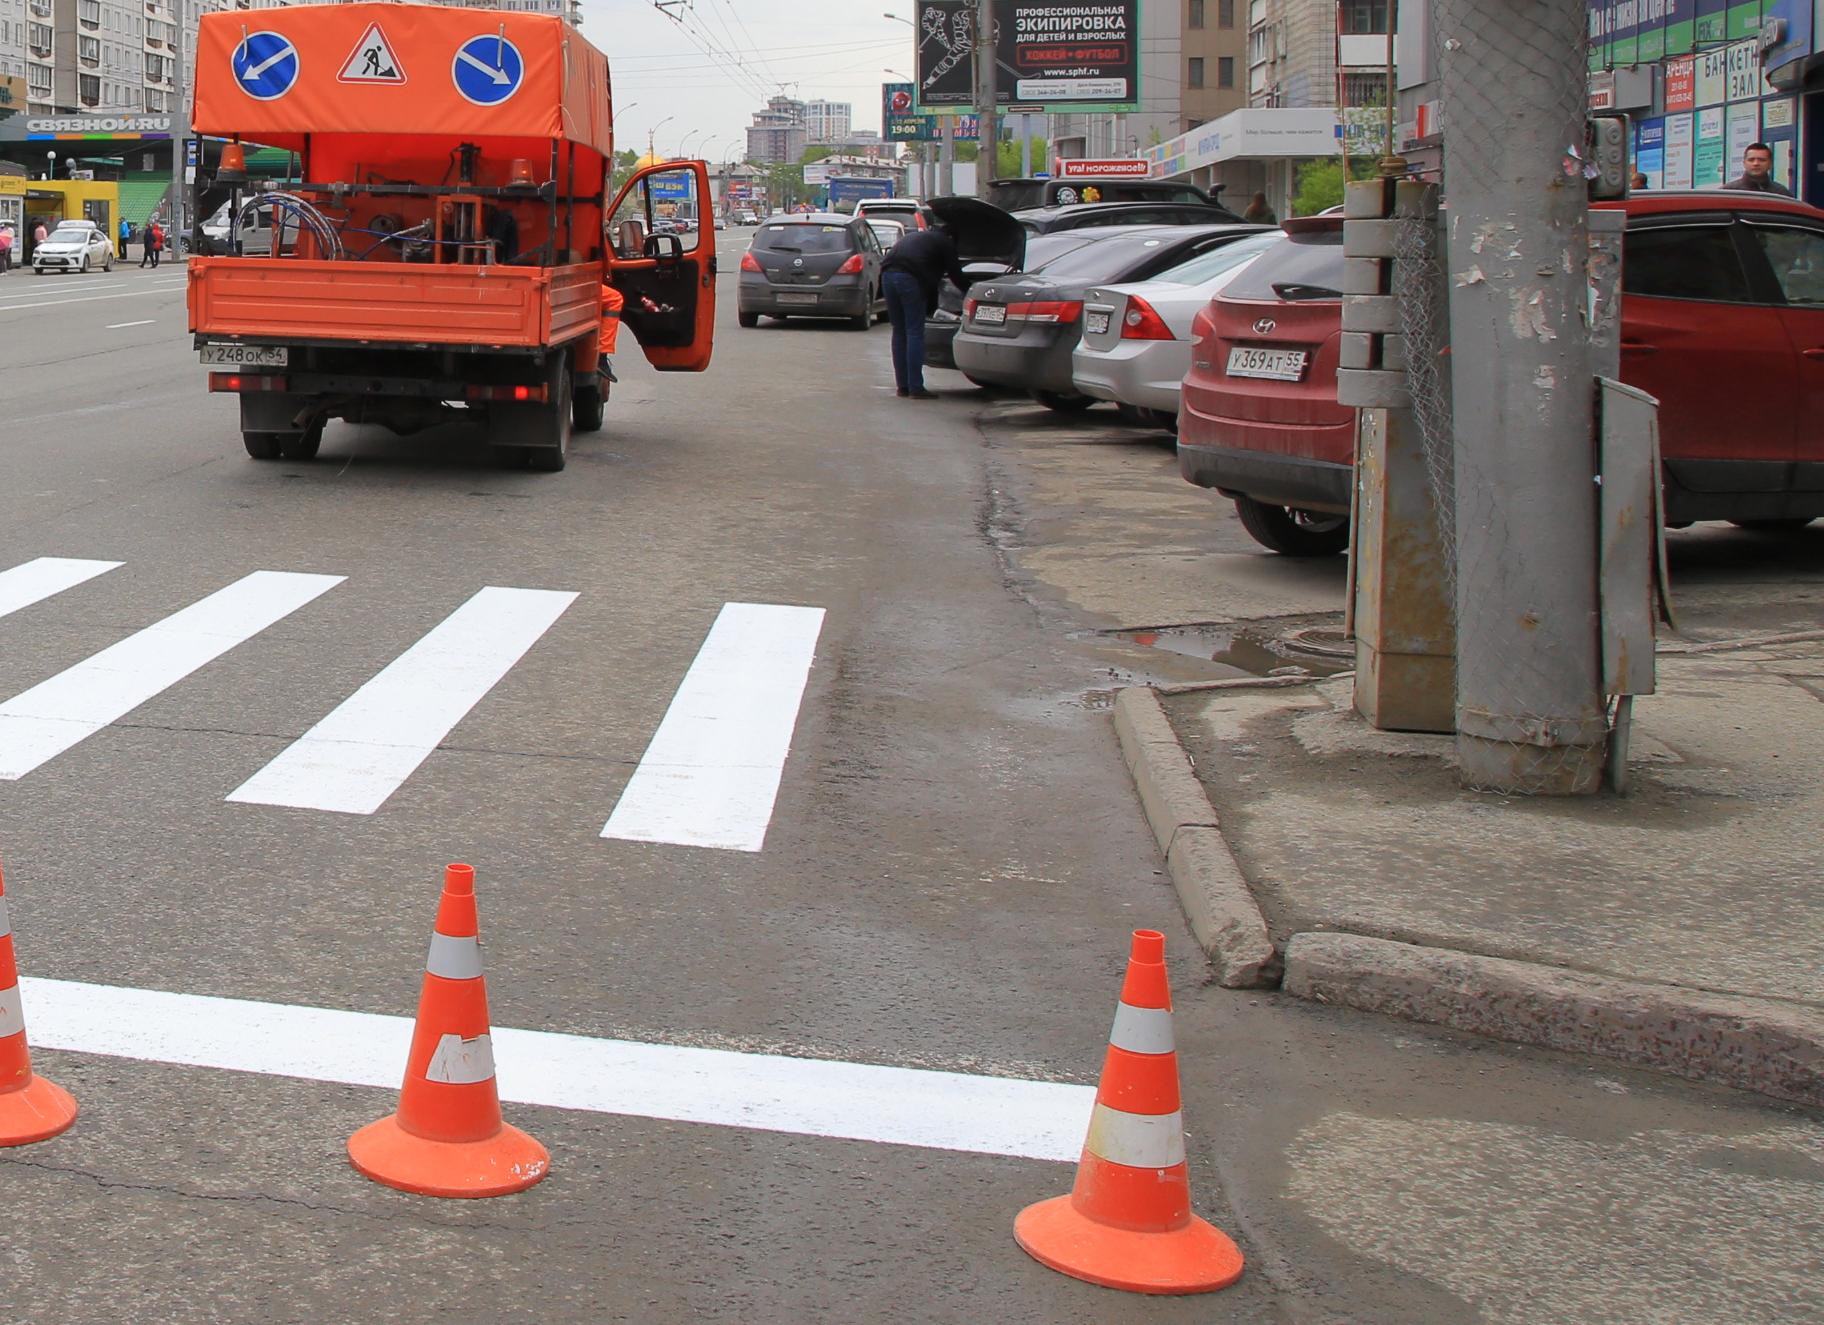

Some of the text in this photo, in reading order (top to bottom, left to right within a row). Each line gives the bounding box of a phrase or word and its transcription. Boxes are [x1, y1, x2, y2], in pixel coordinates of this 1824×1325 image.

[1016, 6, 1125, 17] ПРОФЕССИОНАЛЬНАЯ
[1016, 16, 1126, 31] ЭКИПИРОВКА
[1016, 31, 1126, 42] ДЛЯ ДЕТЕЙ И ВЗРОСЛЫХ
[1026, 48, 1120, 60] ХОККЕЙ ФУТБОЛ
[1705, 45, 1758, 78] БАНКЕТН
[1044, 67, 1100, 77] www.sphf.ru
[1733, 73, 1754, 98] ЗАЛ
[892, 125, 916, 134] 19:00
